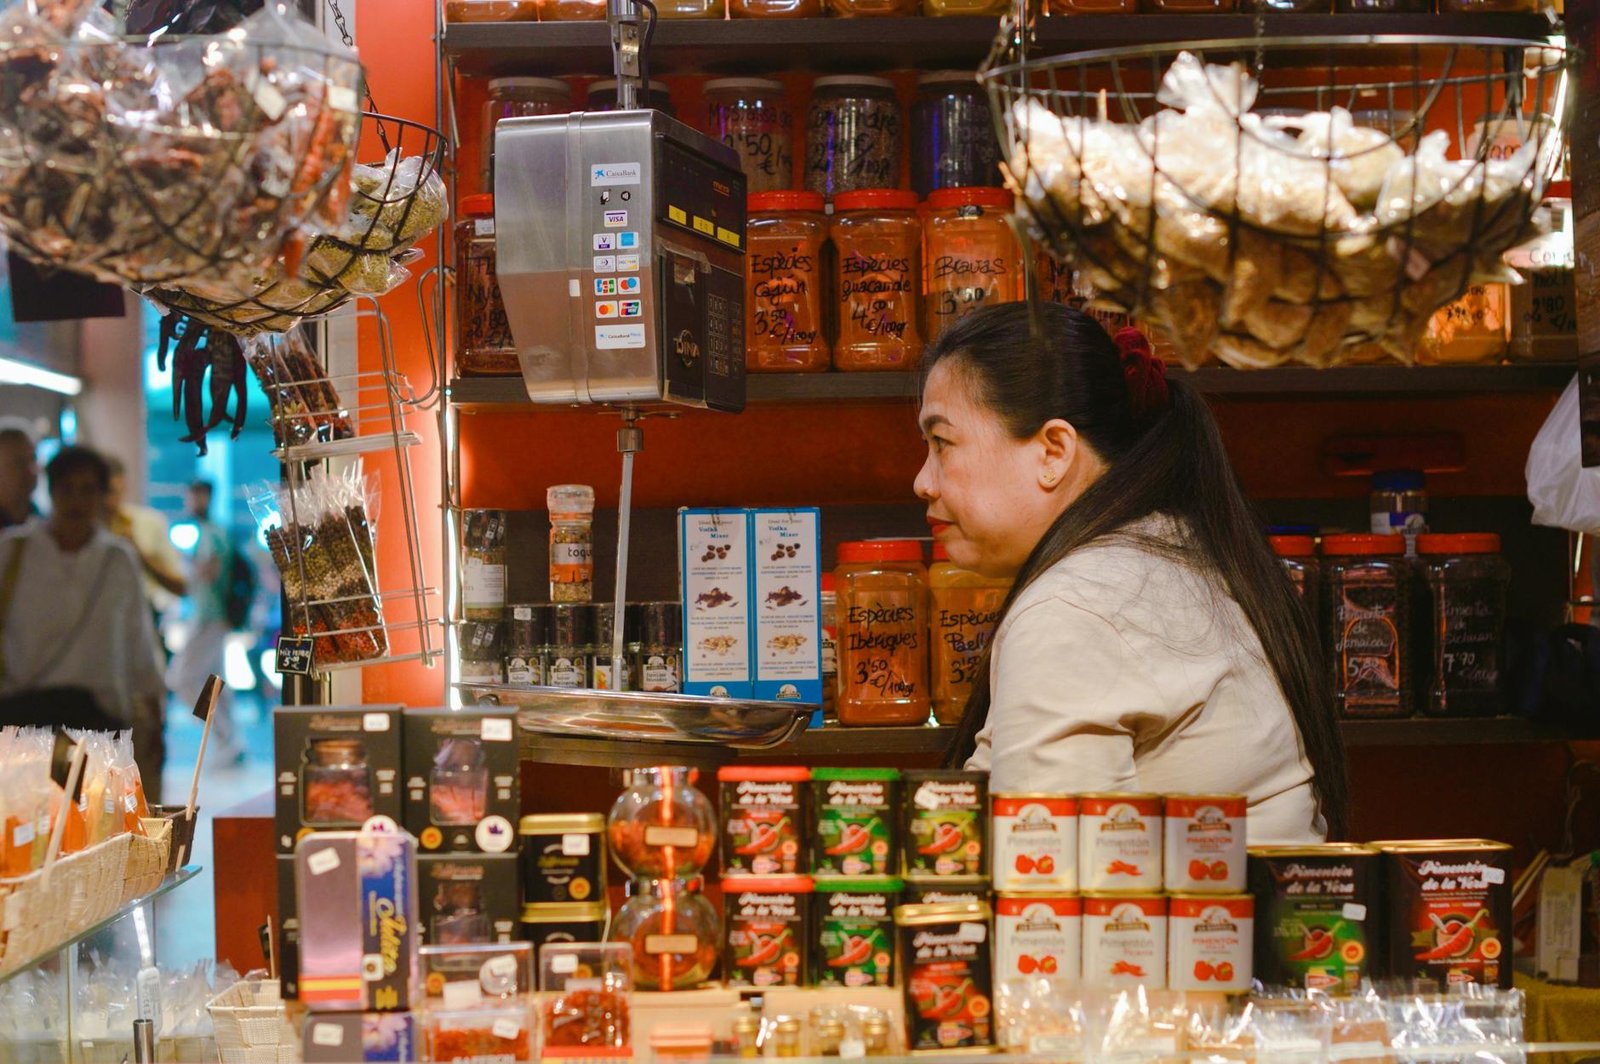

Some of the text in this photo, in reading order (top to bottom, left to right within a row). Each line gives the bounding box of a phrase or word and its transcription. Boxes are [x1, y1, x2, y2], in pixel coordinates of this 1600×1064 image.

[842, 256, 909, 276] Espècies
[935, 256, 1007, 279] Bravas
[597, 280, 614, 293] JCB
[935, 287, 985, 315] 3'50
[754, 309, 786, 335] 3'50
[852, 300, 886, 328] 4'50
[849, 602, 914, 630] Espècies
[848, 632, 917, 656] Ibériques
[855, 658, 888, 684] 3'50
[1283, 863, 1353, 879] Pimentón
[1418, 860, 1487, 876] Pimentón
[1286, 881, 1354, 893] de la Vera
[1421, 876, 1488, 891] de la Vera
